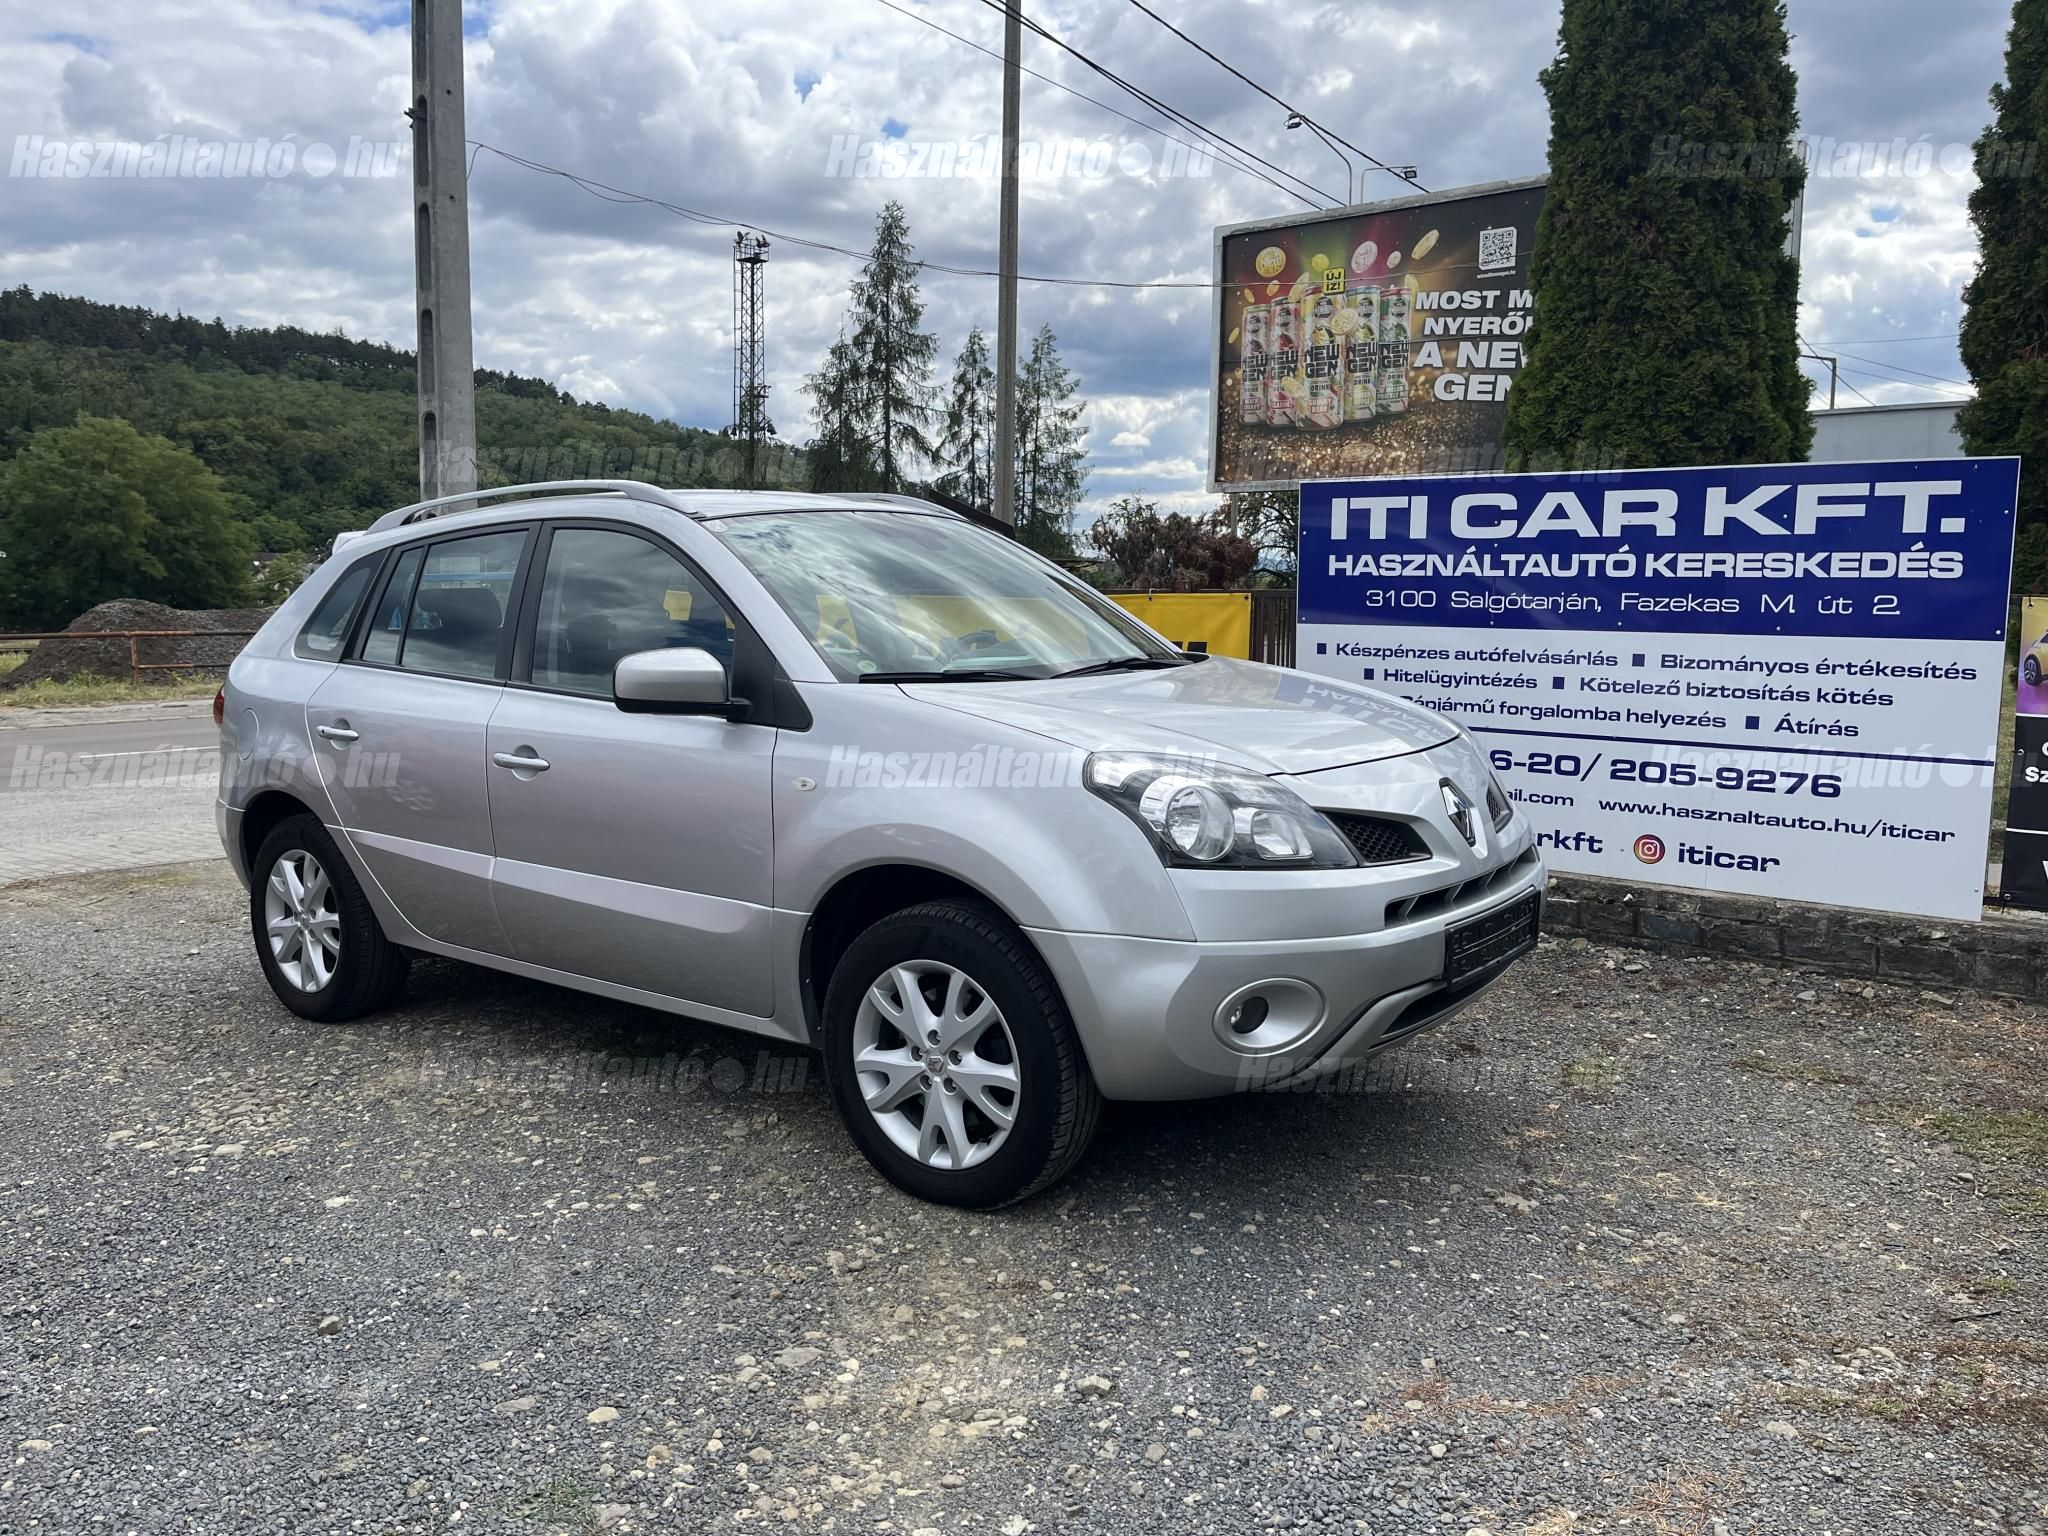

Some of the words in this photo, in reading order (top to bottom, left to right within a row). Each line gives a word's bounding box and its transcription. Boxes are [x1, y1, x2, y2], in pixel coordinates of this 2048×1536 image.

[1326, 272, 1341, 281] ÚJ
[1415, 290, 1501, 310] MOST
[1304, 343, 1340, 363] NEW
[1347, 341, 1377, 360] NEW
[1347, 356, 1377, 373] GEN
[1413, 341, 1443, 368] A
[1304, 361, 1338, 378] GEN
[1330, 495, 1429, 540] ITI
[1450, 488, 1679, 539] CAR
[1703, 479, 1966, 536] KFT.
[1328, 544, 1637, 577] HASZNÁLTAUTÓ
[1644, 541, 1964, 579] KERESKEDÉS
[1366, 590, 1437, 608] 3100
[1450, 591, 1602, 614] Salgótarján,
[1620, 592, 1740, 613] Fazekas
[1817, 596, 1853, 614] út
[1336, 642, 1450, 661] Készpénzes
[1454, 648, 1618, 667] autófelvásárlás
[1660, 653, 1809, 677] Bizományos
[1815, 658, 1977, 680] értékesítés
[1384, 669, 1538, 689] Hitelügyintézés
[1580, 677, 1681, 696] Kötelező
[1686, 681, 1810, 702] biztosítás
[1816, 688, 1894, 706] kötés
[1499, 701, 1624, 723] forgalomba
[1626, 709, 1727, 728] helyezés
[1774, 712, 1859, 737] Átírás
[1610, 758, 1842, 798] 205-9276
[1598, 800, 1956, 842] www.hasznaltauto.hu/iticar
[1678, 843, 1781, 872] iticar
